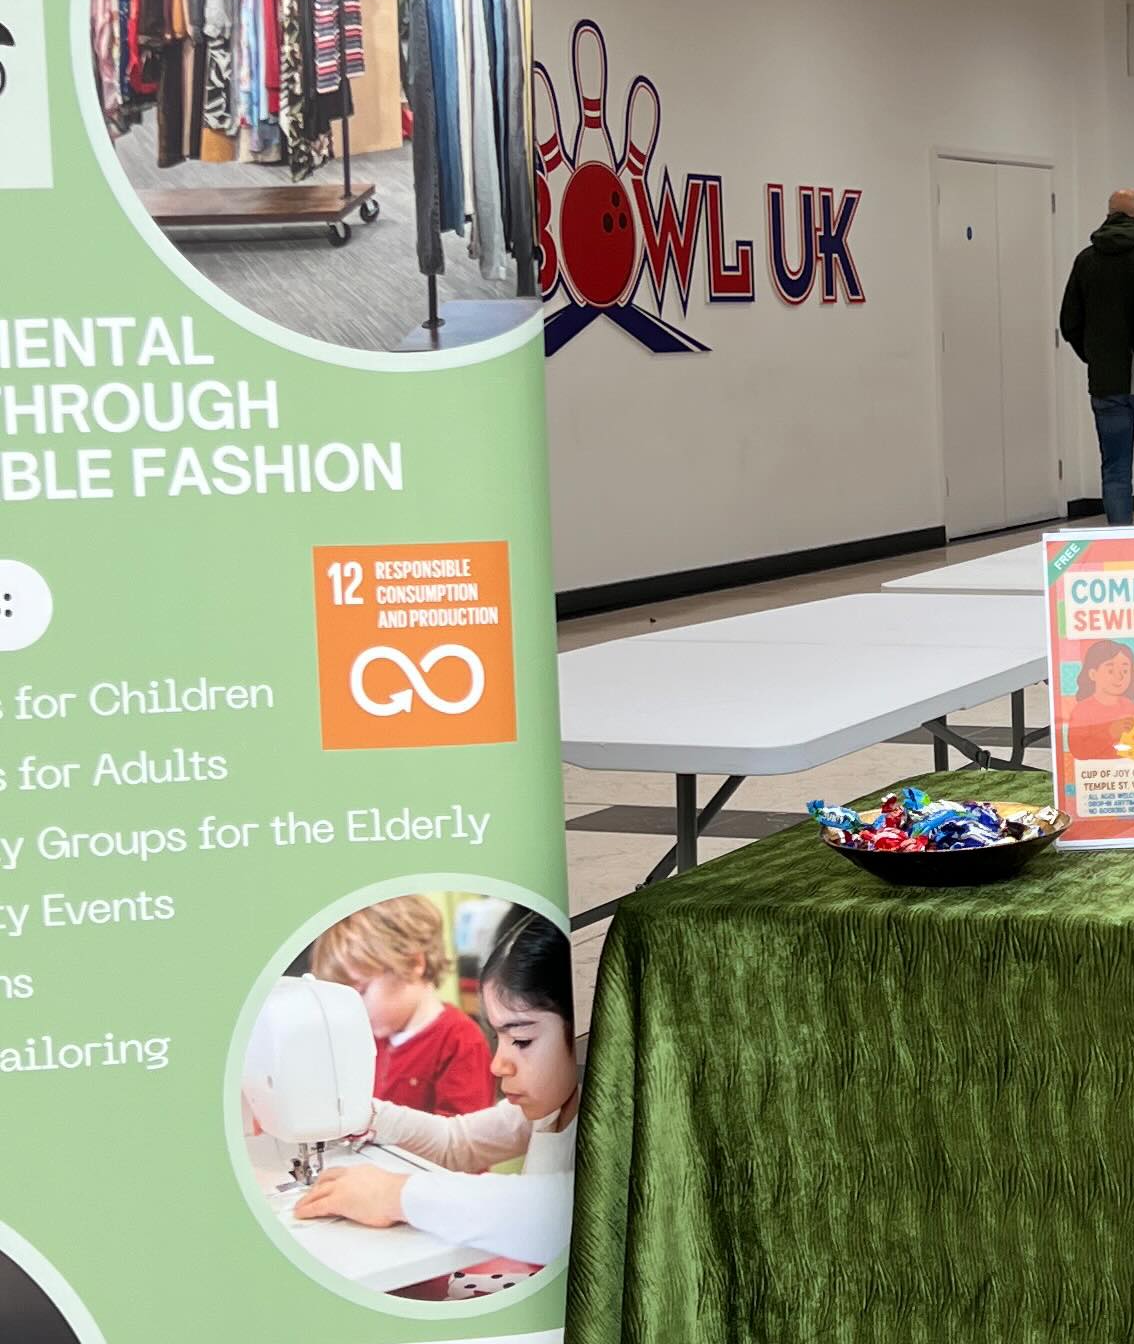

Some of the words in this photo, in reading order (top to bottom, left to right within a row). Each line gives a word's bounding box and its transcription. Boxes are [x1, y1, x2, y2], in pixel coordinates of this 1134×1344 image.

[767, 183, 866, 305] UK
[0, 316, 215, 368] ENTAL
[0, 380, 279, 435] HROUGH
[132, 442, 404, 496] FASHION
[374, 559, 472, 580] RESPONSIBLE
[1053, 542, 1081, 571] FREE
[327, 561, 365, 606] 12
[375, 583, 479, 605] CONSUMPTION
[377, 610, 408, 629] AND
[409, 606, 499, 627] PRODUCTION
[15, 684, 77, 720] for
[89, 677, 275, 716] Children
[18, 755, 81, 790] for
[93, 747, 229, 787] Adults
[1081, 770, 1098, 779] CUP
[1100, 769, 1111, 778] OF
[1113, 769, 1129, 778] JOY
[1084, 782, 1115, 791] TEMPLE
[37, 826, 188, 862] Groups
[198, 816, 260, 850] for
[269, 811, 336, 846] the
[346, 805, 492, 845] Elderly
[42, 890, 176, 927] Events
